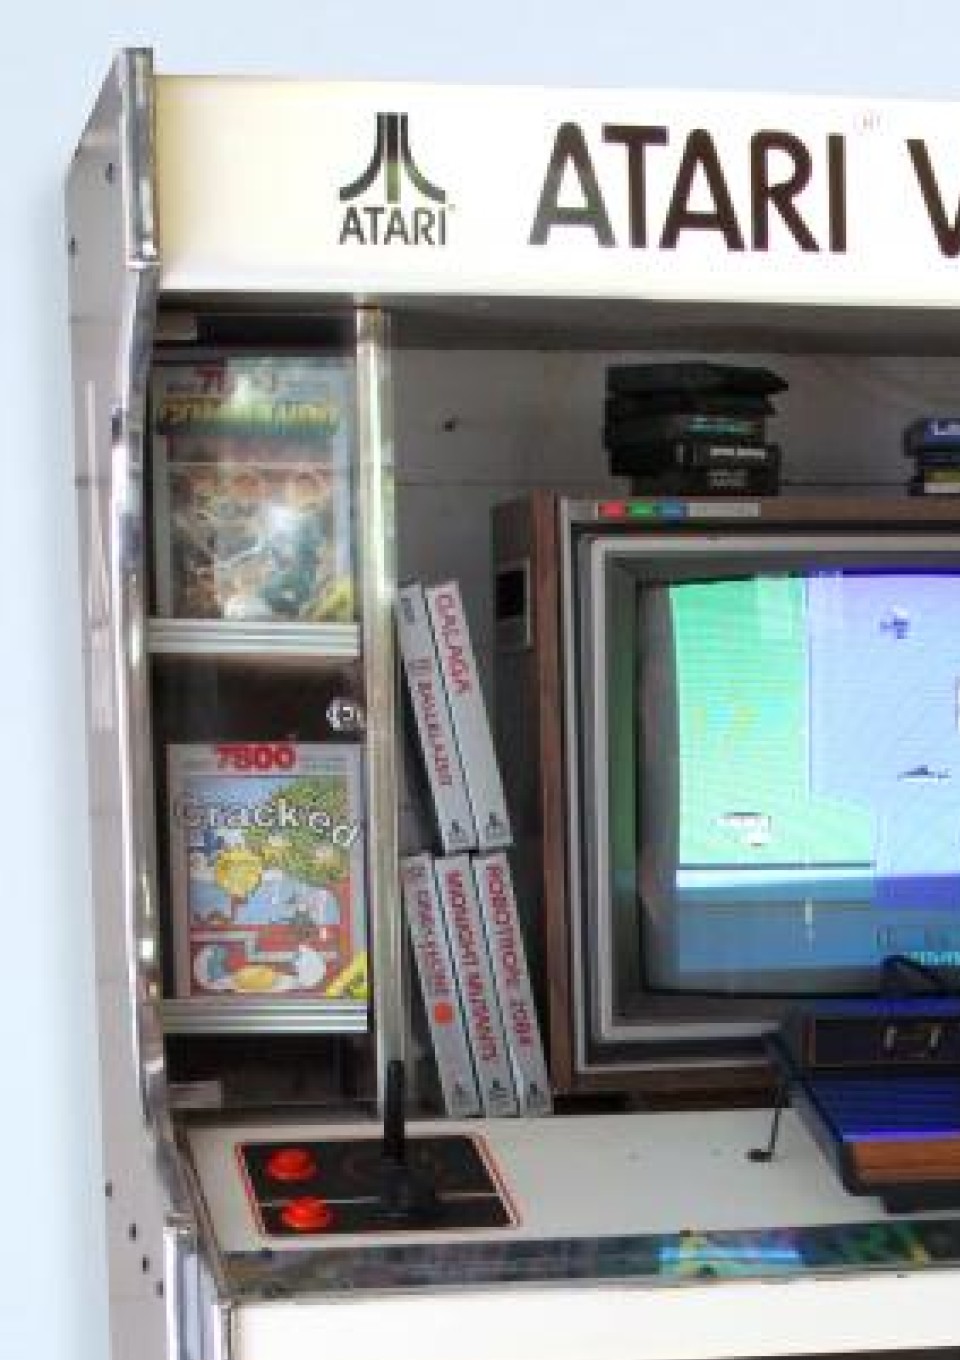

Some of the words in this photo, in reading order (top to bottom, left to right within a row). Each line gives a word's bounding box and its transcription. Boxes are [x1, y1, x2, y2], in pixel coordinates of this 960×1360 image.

[527, 121, 847, 254] ATARI
[339, 206, 447, 246] ATARI
[434, 594, 472, 694] GALAGA
[216, 742, 296, 770] 7800
